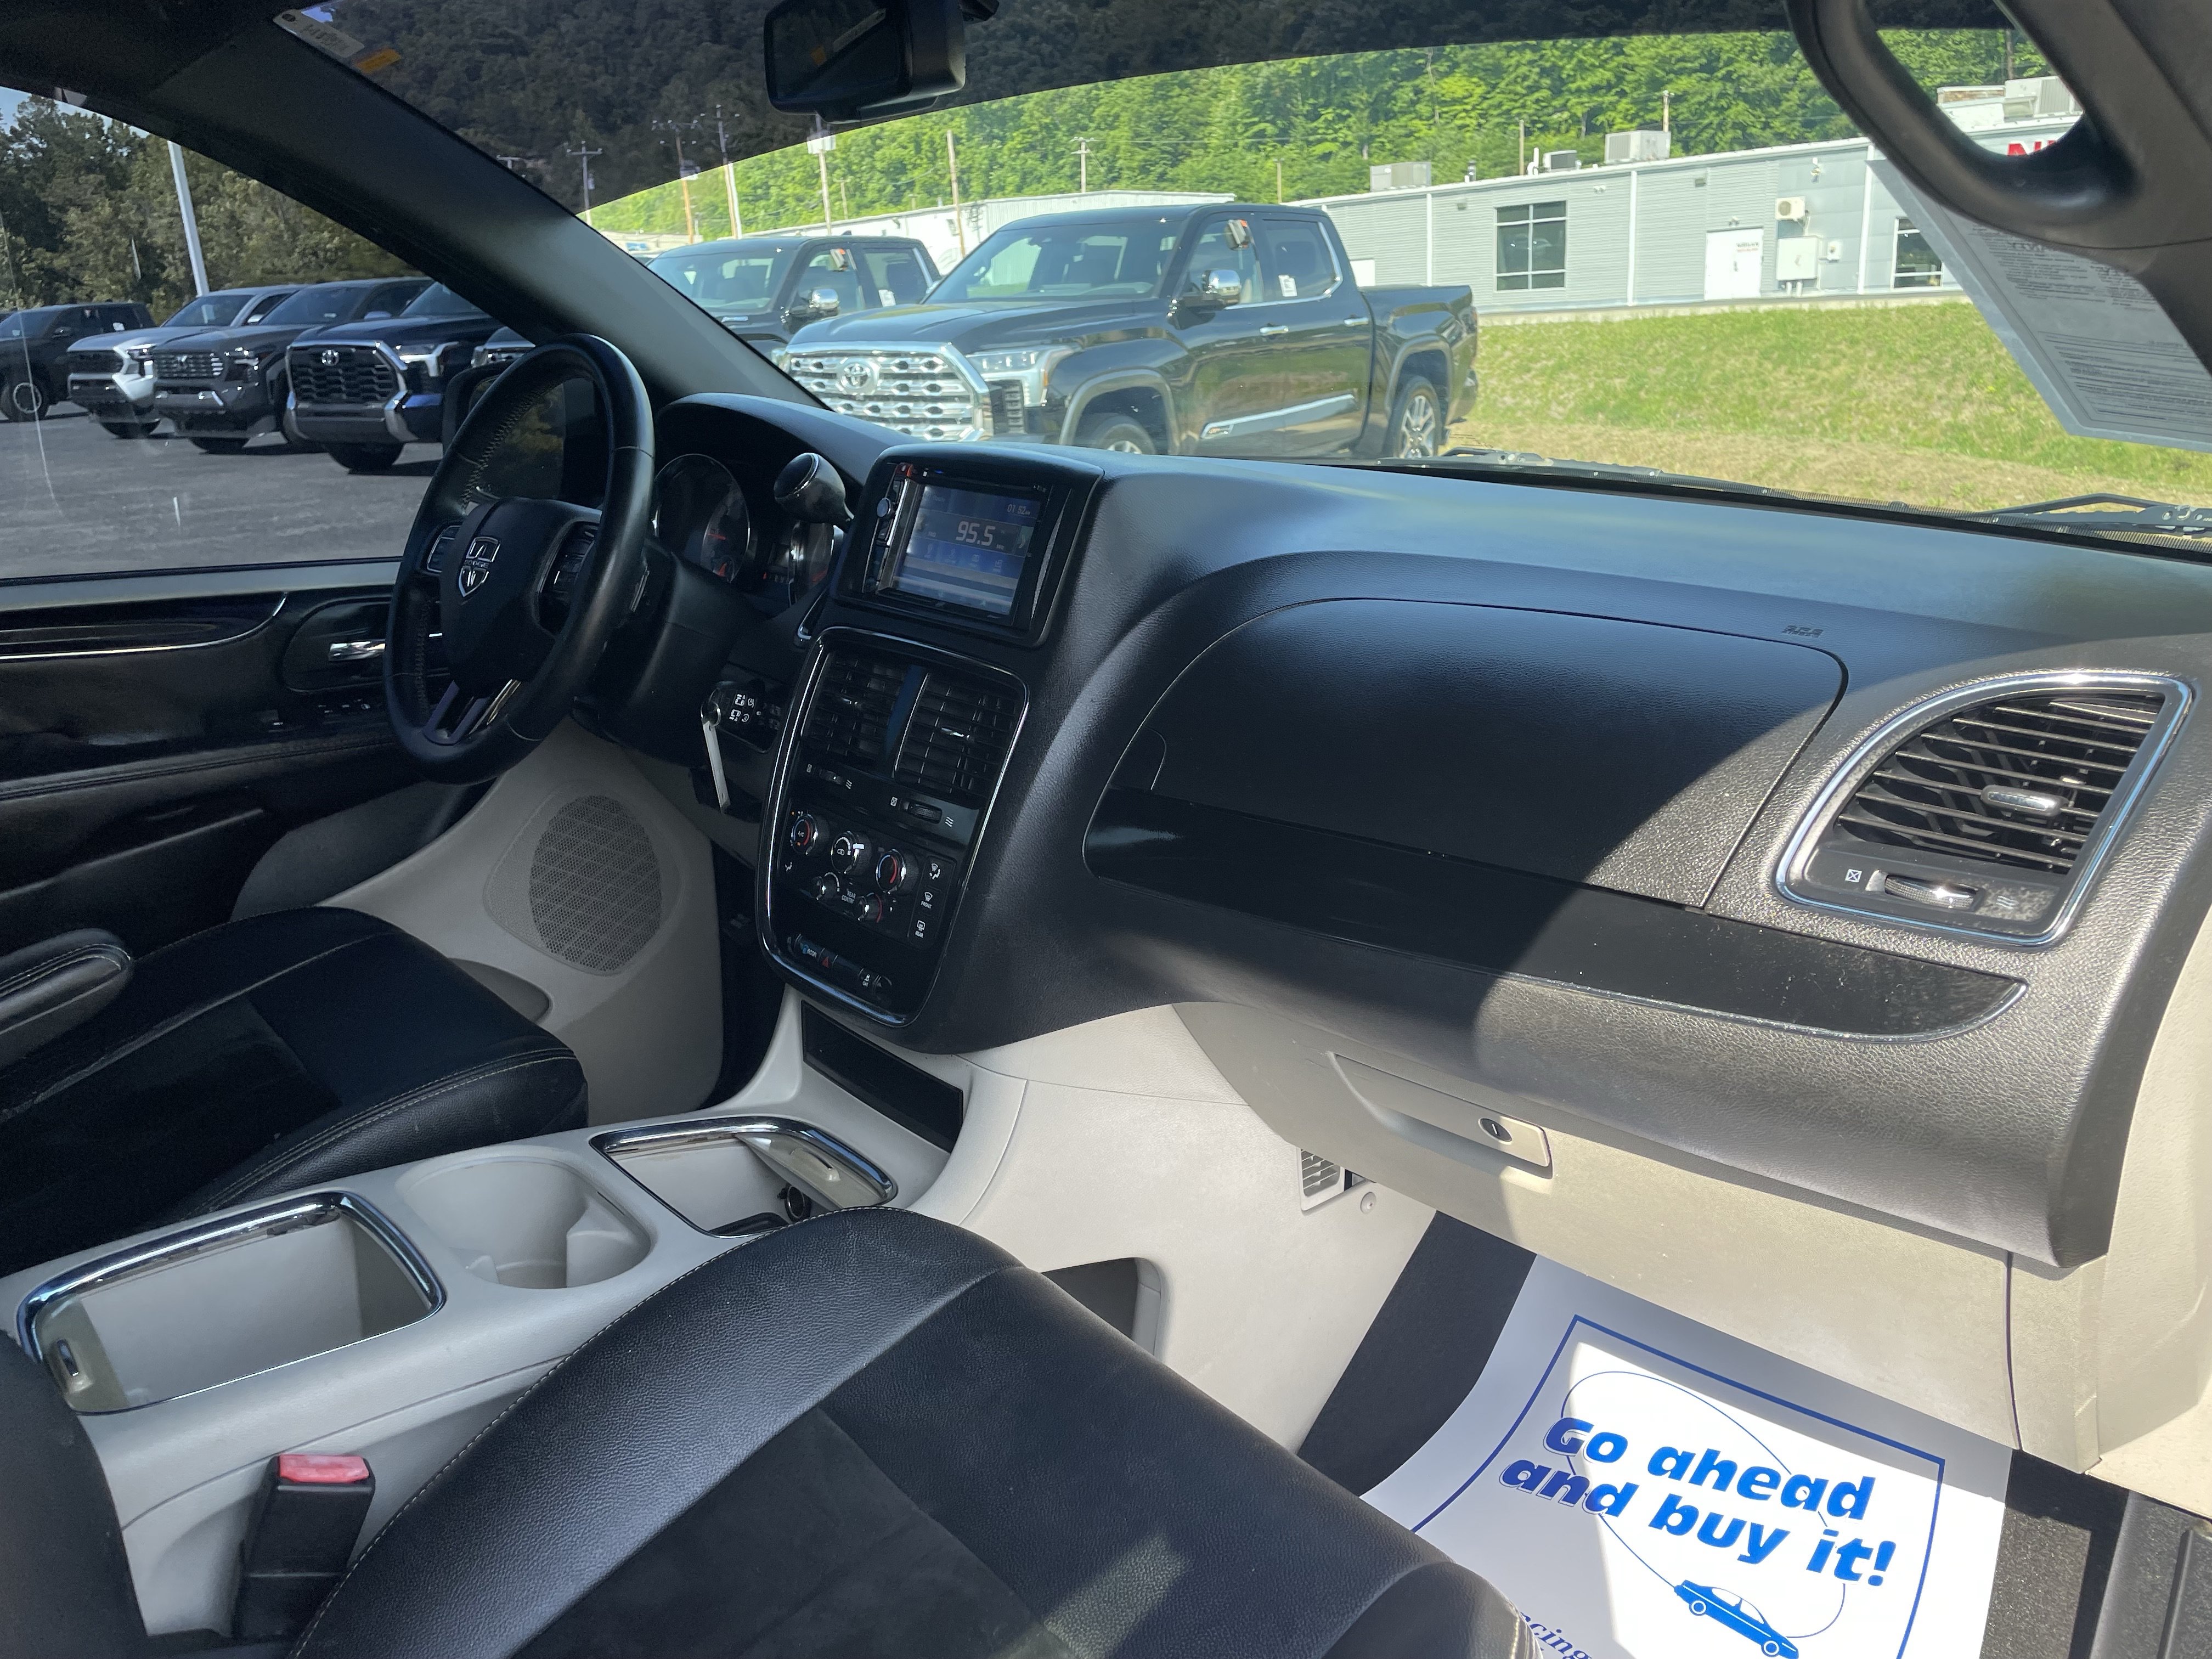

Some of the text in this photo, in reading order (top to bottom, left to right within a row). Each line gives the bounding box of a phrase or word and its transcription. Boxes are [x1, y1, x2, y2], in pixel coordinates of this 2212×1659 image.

[955, 521, 996, 547] 95.5
[806, 948, 817, 958] econ
[1543, 1417, 1876, 1520] Go ahead
[1499, 1459, 1897, 1586] and buy it!
